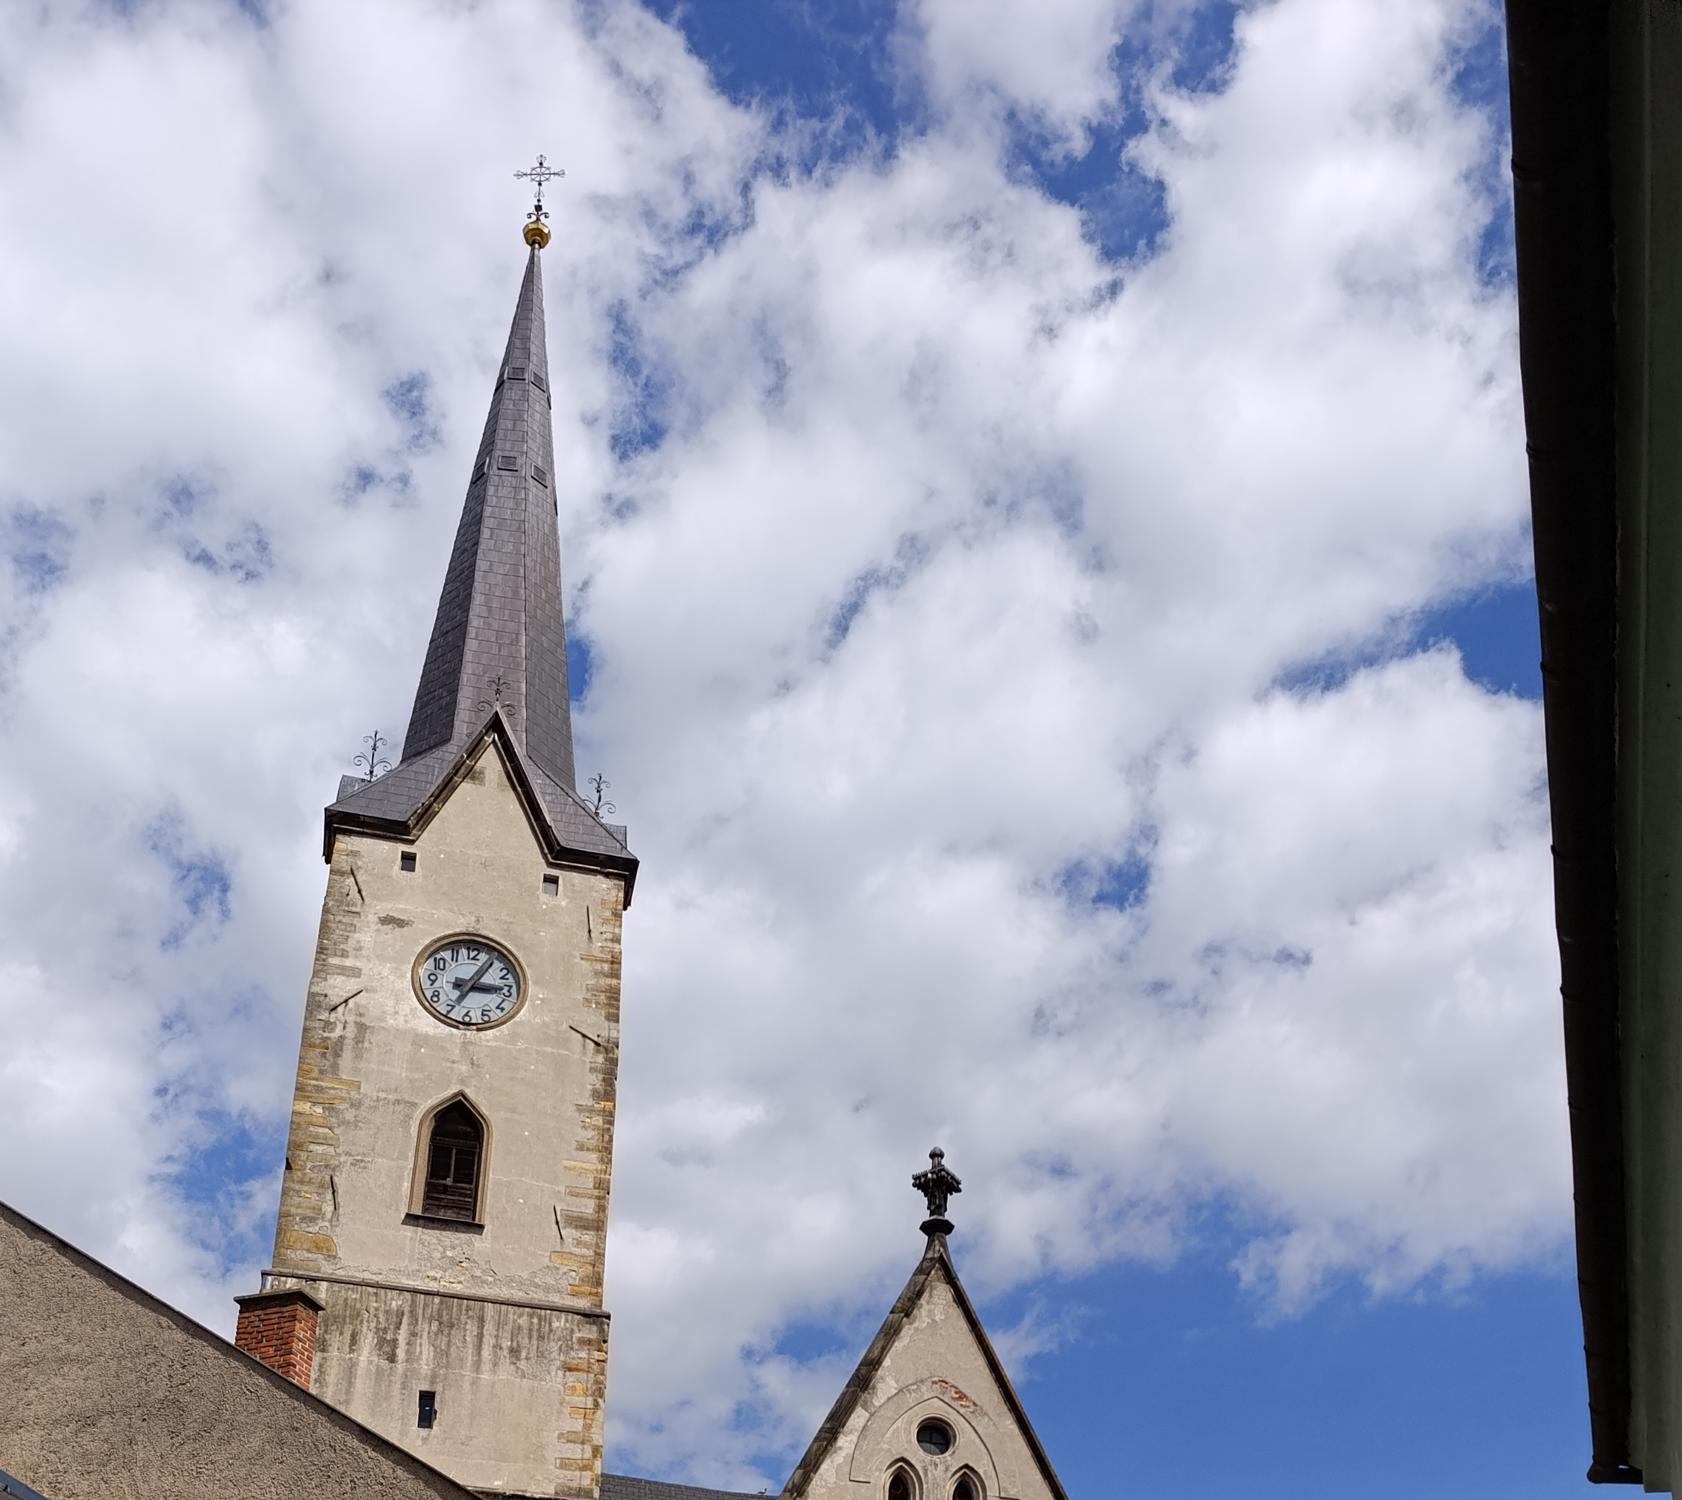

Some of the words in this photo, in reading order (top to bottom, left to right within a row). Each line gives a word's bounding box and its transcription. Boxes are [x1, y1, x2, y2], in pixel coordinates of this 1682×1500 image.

[451, 948, 460, 962] 11
[466, 946, 480, 961] 12
[433, 957, 446, 971] 10
[427, 973, 438, 986] 9
[499, 967, 510, 981] 2
[430, 990, 440, 1003] 8
[502, 984, 513, 998] 3
[446, 1003, 456, 1016] 7
[495, 999, 506, 1013] 4
[461, 1009, 472, 1022] 6
[480, 1009, 492, 1022] 5
